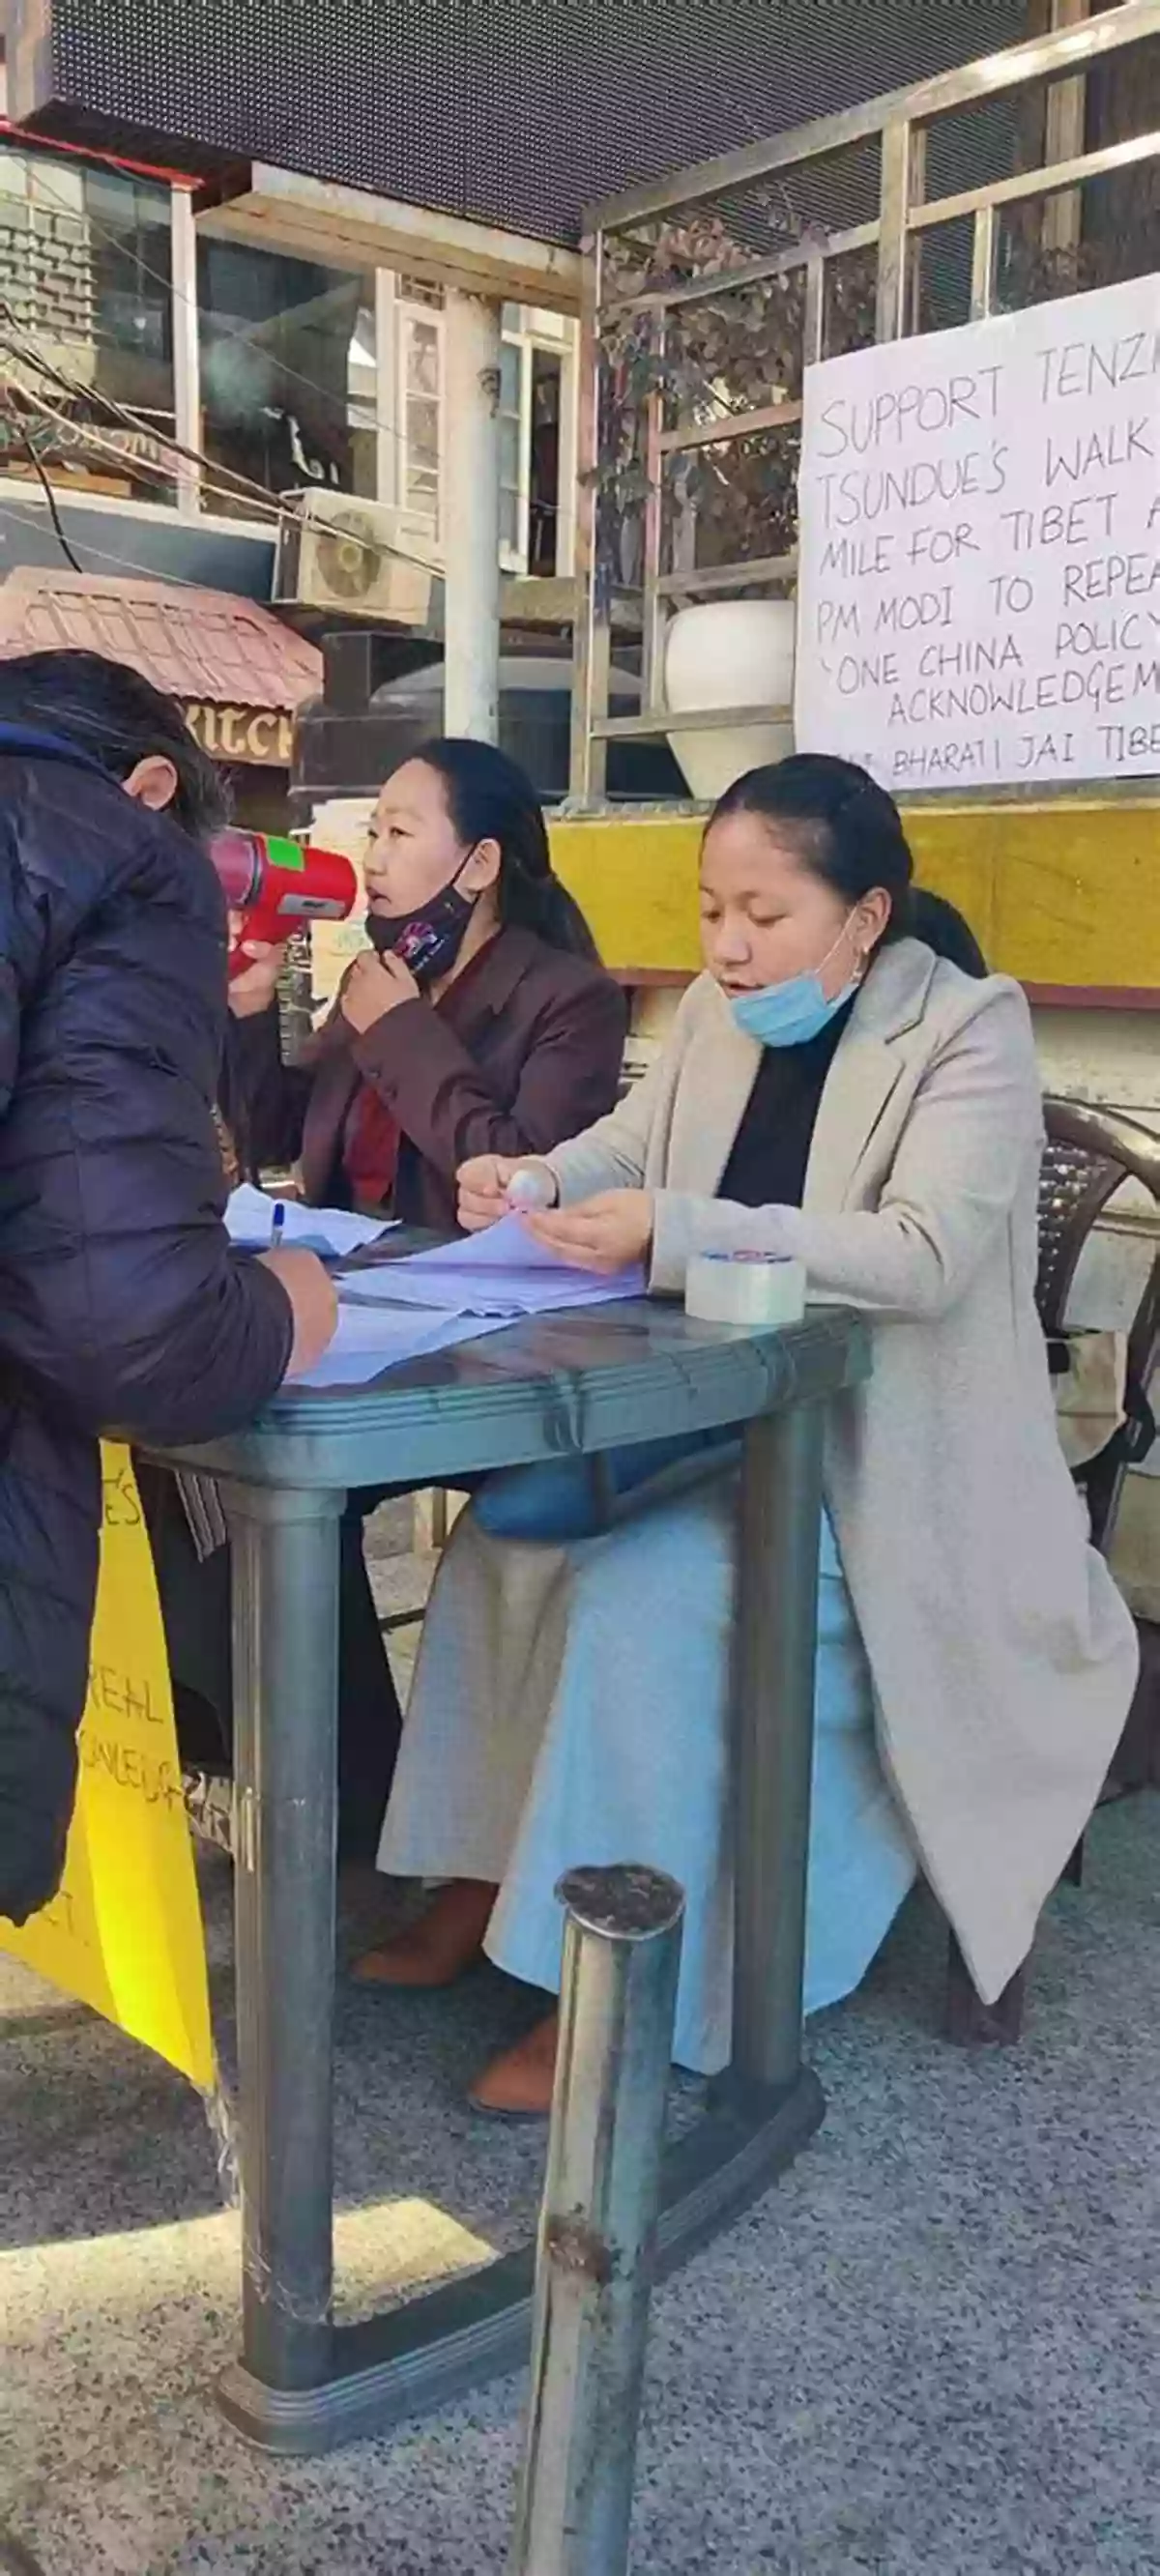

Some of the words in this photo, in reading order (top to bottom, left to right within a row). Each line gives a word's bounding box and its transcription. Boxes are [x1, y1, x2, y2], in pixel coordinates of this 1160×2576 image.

[818, 365, 1003, 458] SUPPORT
[816, 440, 1008, 530] TSUNDUE'S
[1046, 417, 1155, 487] WALK
[820, 535, 895, 578] MILE
[907, 522, 981, 565] FOR
[1001, 492, 1118, 552] TIBET
[818, 600, 860, 645] PM
[874, 586, 953, 632] MODI
[990, 576, 1033, 614] TO
[918, 634, 1024, 678] CHINA
[892, 738, 1000, 776] BHARATI
[1017, 733, 1075, 768] JAI
